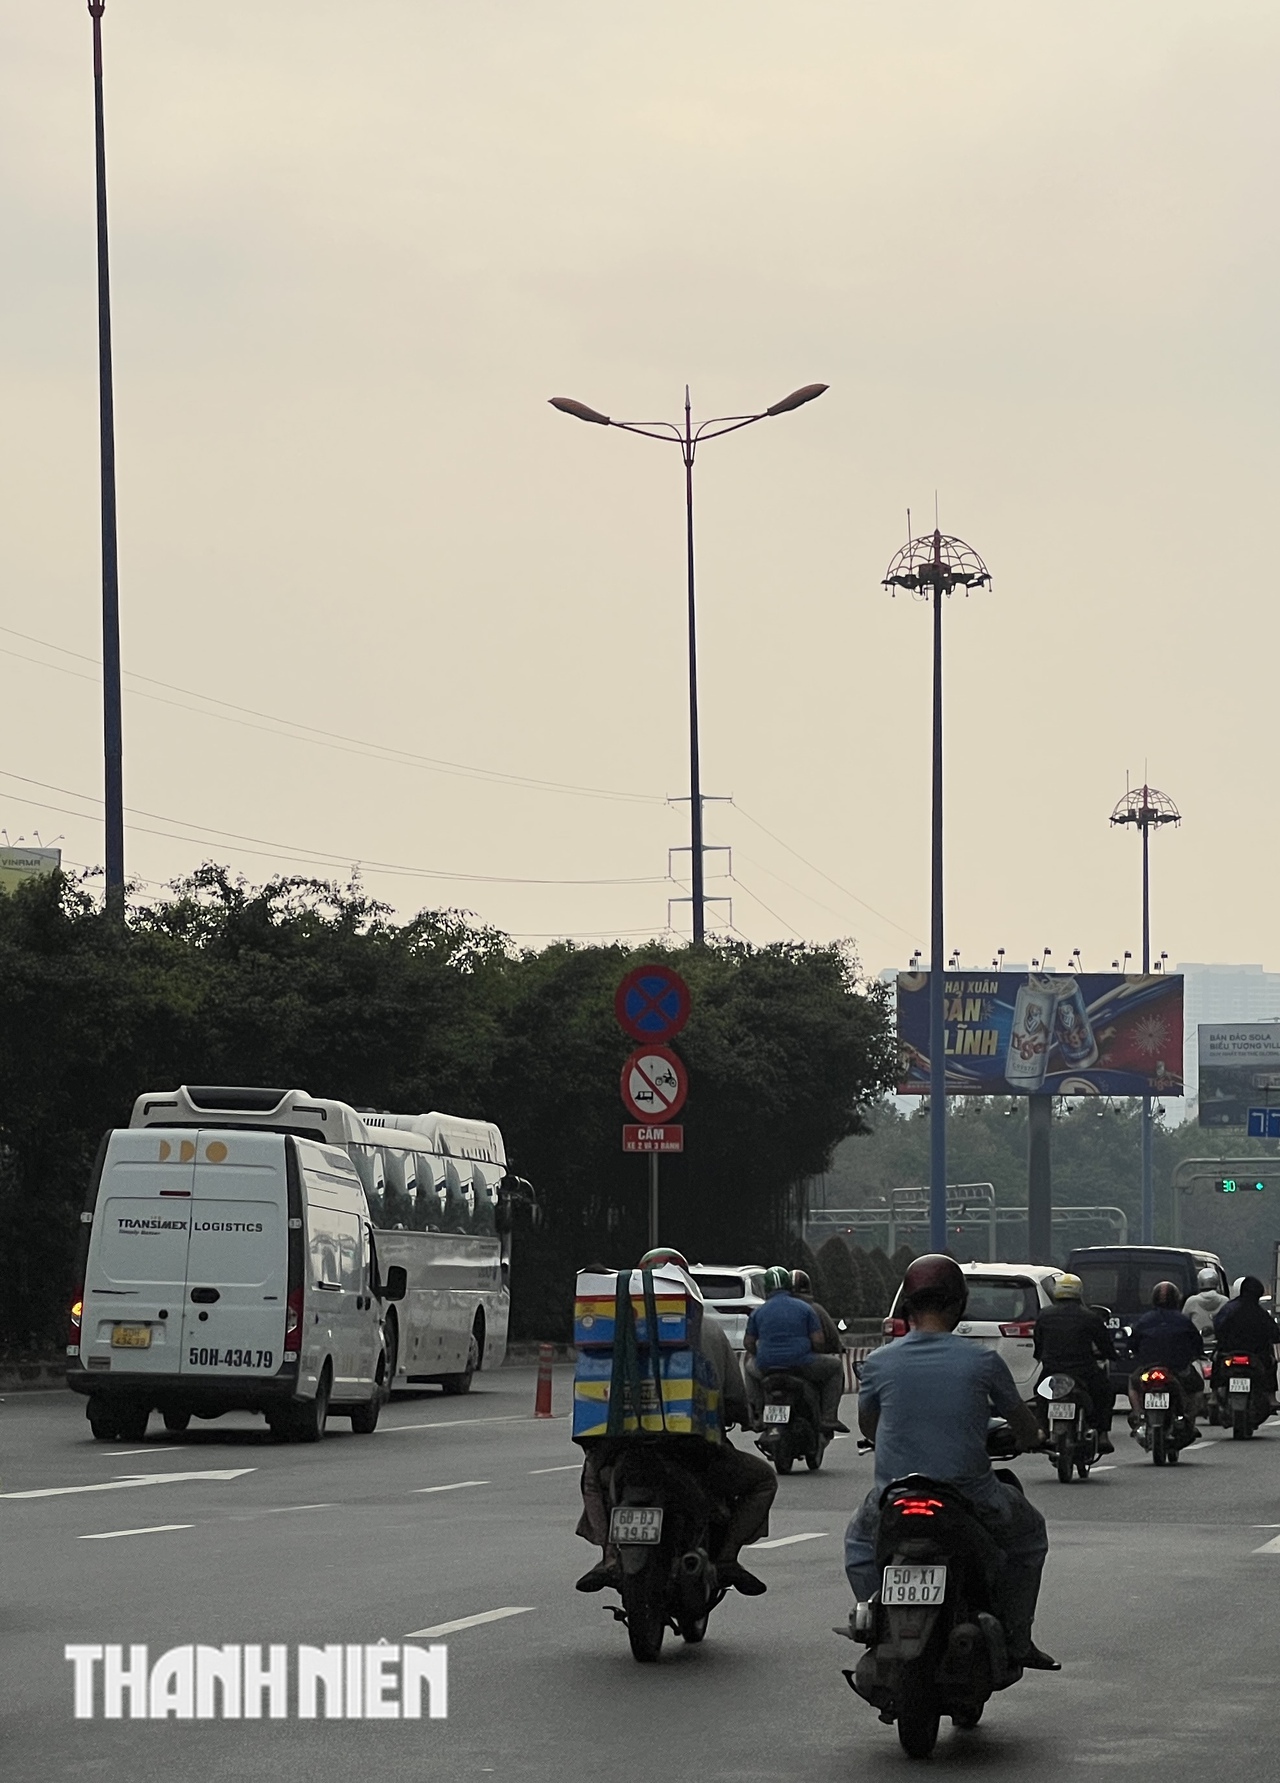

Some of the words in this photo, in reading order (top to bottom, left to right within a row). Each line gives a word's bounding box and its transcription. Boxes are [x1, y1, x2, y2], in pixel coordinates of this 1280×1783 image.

[943, 981, 964, 993] HAI
[967, 979, 998, 994] XUÂN
[944, 1023, 998, 1056] LĨNH
[1210, 1033, 1227, 1041] BÁN
[1229, 1032, 1247, 1041] ĐẢO
[1147, 1077, 1175, 1092] Tiger
[638, 1125, 664, 1140] CẤM
[627, 1141, 636, 1150] XE
[637, 1142, 643, 1150] 2
[654, 1142, 659, 1150] 3
[1222, 1179, 1236, 1193] 30
[118, 1218, 188, 1231] TRANSIMEX
[194, 1221, 263, 1233] LOGISTICS
[189, 1348, 273, 1369] 50H-434.79
[893, 1568, 936, 1585] 50-X1
[886, 1586, 942, 1602] 198.07
